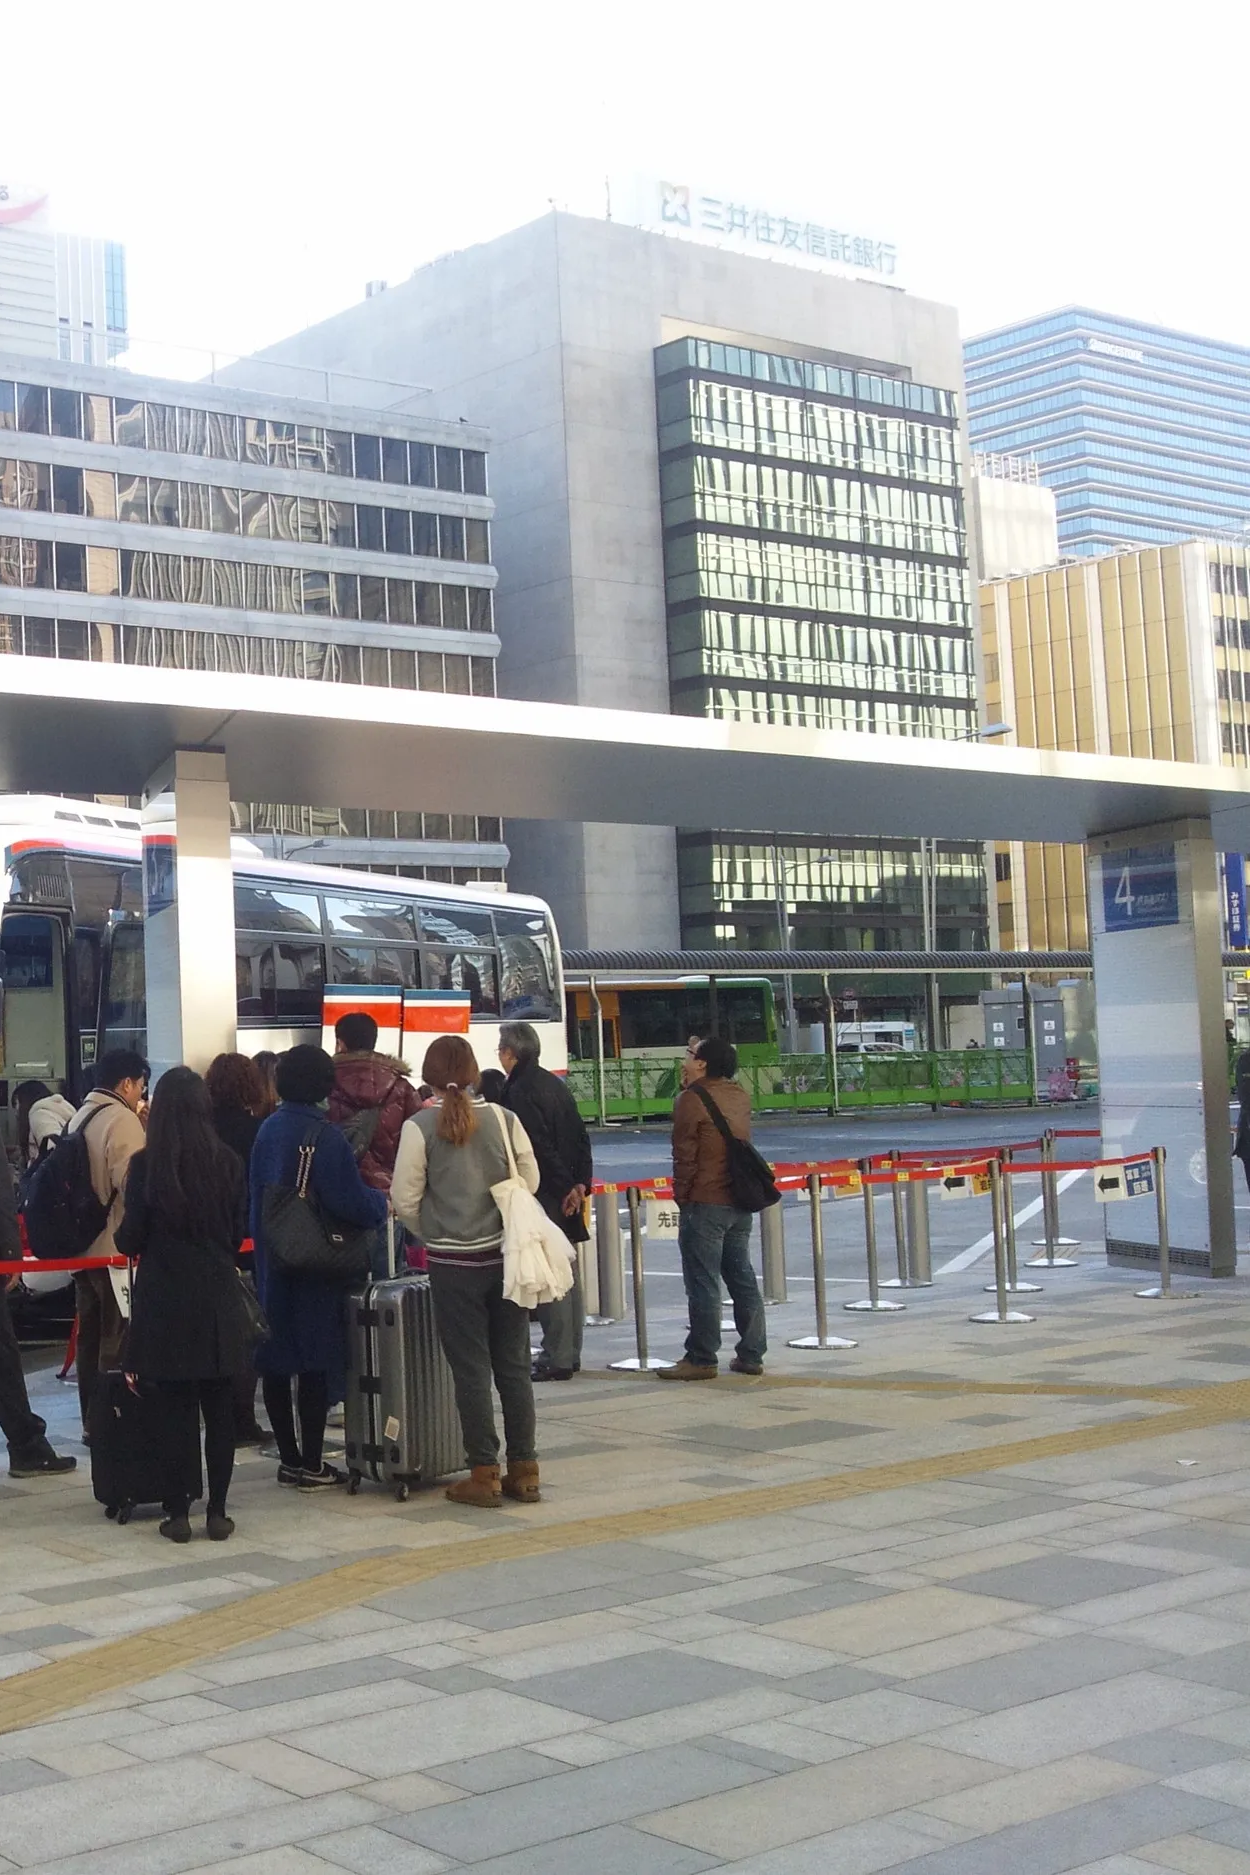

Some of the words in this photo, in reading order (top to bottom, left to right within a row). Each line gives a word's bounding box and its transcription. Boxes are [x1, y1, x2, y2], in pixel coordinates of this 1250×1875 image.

[700, 196, 898, 276] 三井住友信託銀行
[1115, 867, 1135, 916] 4
